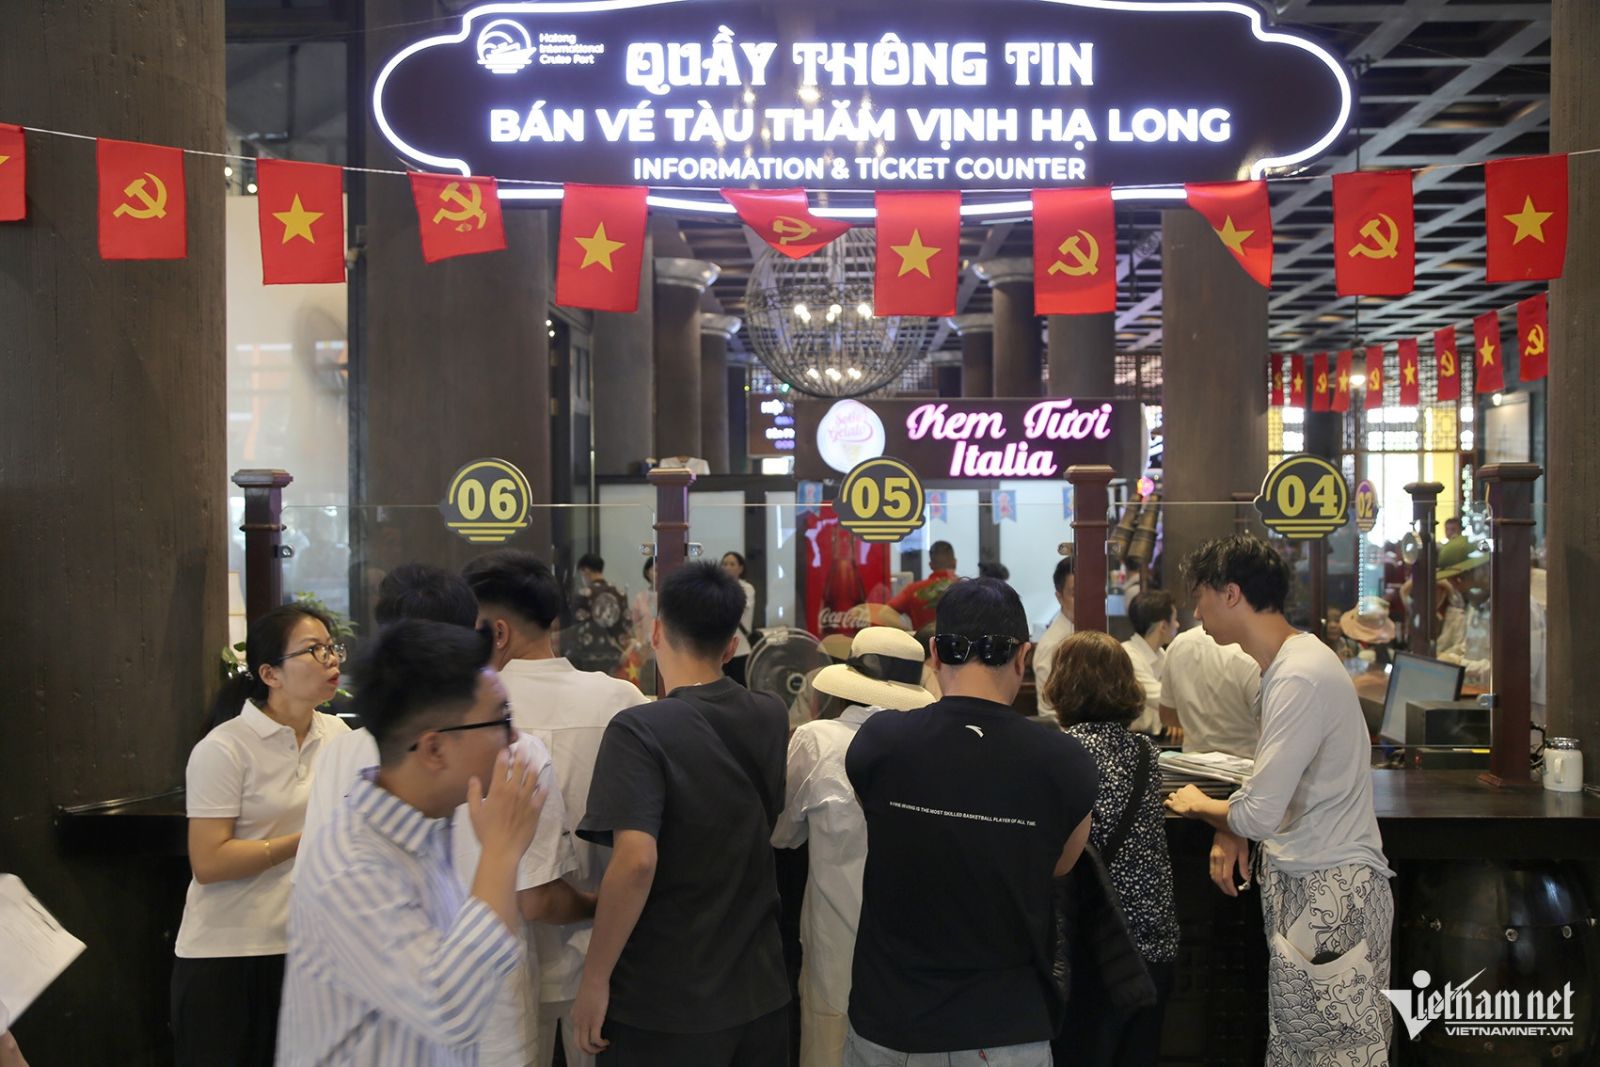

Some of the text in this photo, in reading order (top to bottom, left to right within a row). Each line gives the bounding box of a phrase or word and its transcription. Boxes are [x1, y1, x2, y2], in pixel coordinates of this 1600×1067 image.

[539, 43, 605, 54] International
[573, 54, 595, 64] Port
[626, 25, 1094, 95] QUẦY THÔNG TIN
[490, 100, 1231, 151] BÁN VÉ TÀU THĂM VỊNH HẠ LONG
[634, 157, 1086, 180] INFORMATION & TICKET COUNTER
[906, 398, 1113, 440] Kem Tươi
[949, 440, 1058, 477] Italia
[457, 478, 517, 520] 06
[851, 475, 911, 519] 05
[1277, 474, 1338, 517] 04
[1358, 491, 1373, 518] 02
[944, 810, 963, 818] SKILLED
[963, 812, 993, 822] BASKETBALL
